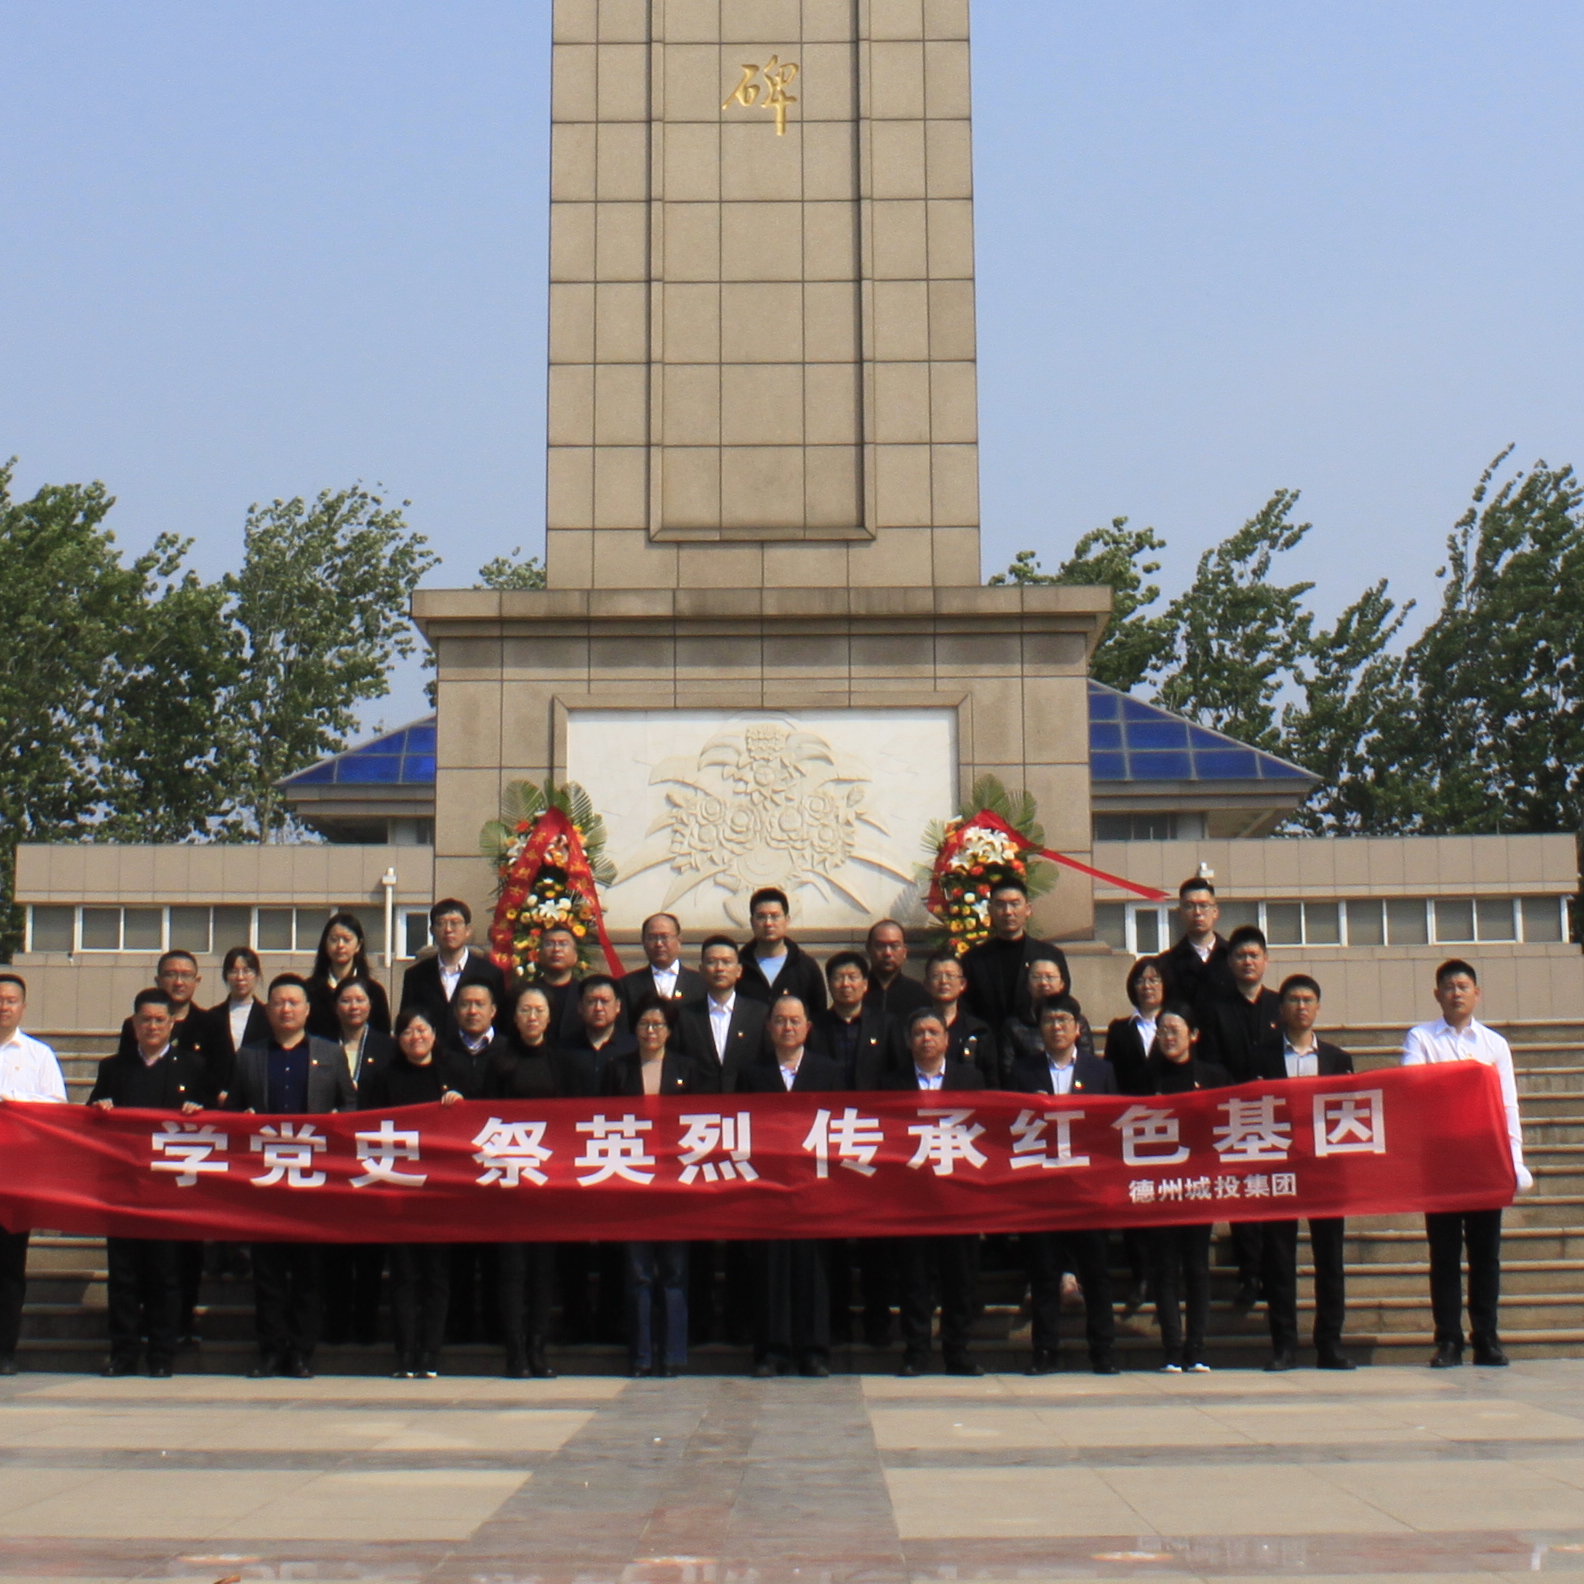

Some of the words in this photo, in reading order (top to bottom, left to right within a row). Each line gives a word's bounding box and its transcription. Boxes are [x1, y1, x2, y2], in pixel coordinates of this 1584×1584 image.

[150, 1120, 428, 1188] 学党史
[471, 1111, 760, 1187] 祭英烈
[802, 1088, 1387, 1179] 传承红色基因
[1128, 1172, 1297, 1203] 德州城投集团
